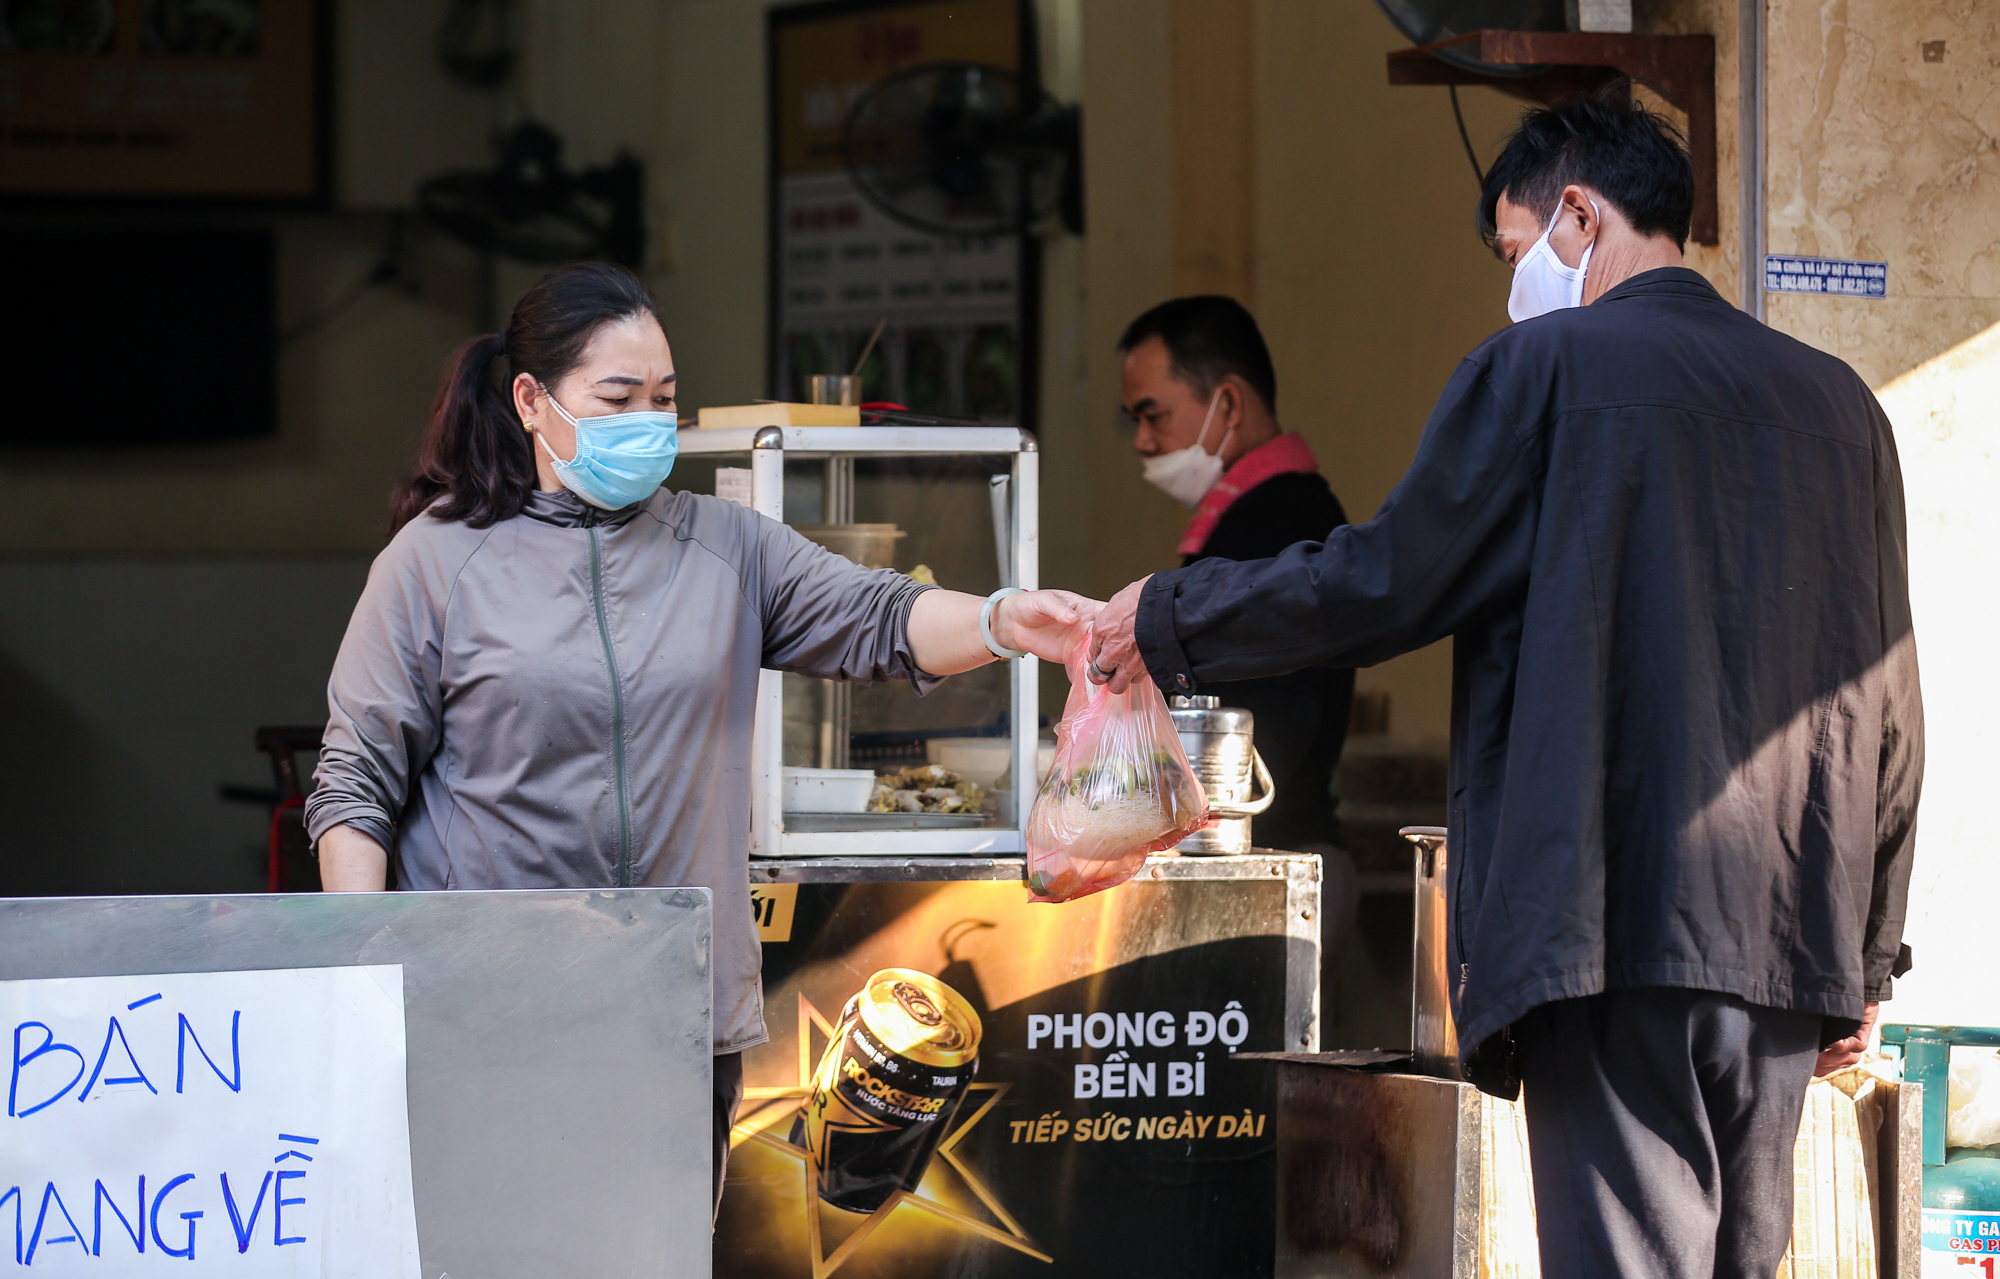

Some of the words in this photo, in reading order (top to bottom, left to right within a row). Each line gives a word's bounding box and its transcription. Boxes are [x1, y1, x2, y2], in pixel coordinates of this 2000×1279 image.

[1027, 1011, 1176, 1049] PHONG
[1184, 1000, 1249, 1054] ĐỘ
[8, 992, 241, 1118] BÁN
[1073, 1050, 1157, 1099] BỀN
[1167, 1051, 1206, 1097] BỈ
[842, 1056, 946, 1113] ROCKSTAR
[932, 1075, 958, 1087] TAURIN
[856, 1087, 887, 1111] NƯỚC
[887, 1104, 917, 1121] TĂNG
[1009, 1110, 1069, 1144] TIẾP
[1073, 1111, 1132, 1142] SỨC
[1135, 1110, 1215, 1141] NGÀY
[1216, 1108, 1267, 1138] DÀI
[219, 1133, 320, 1254] VỀ
[1949, 1237, 1983, 1251] GAS
[1955, 1219, 1975, 1236] TY
